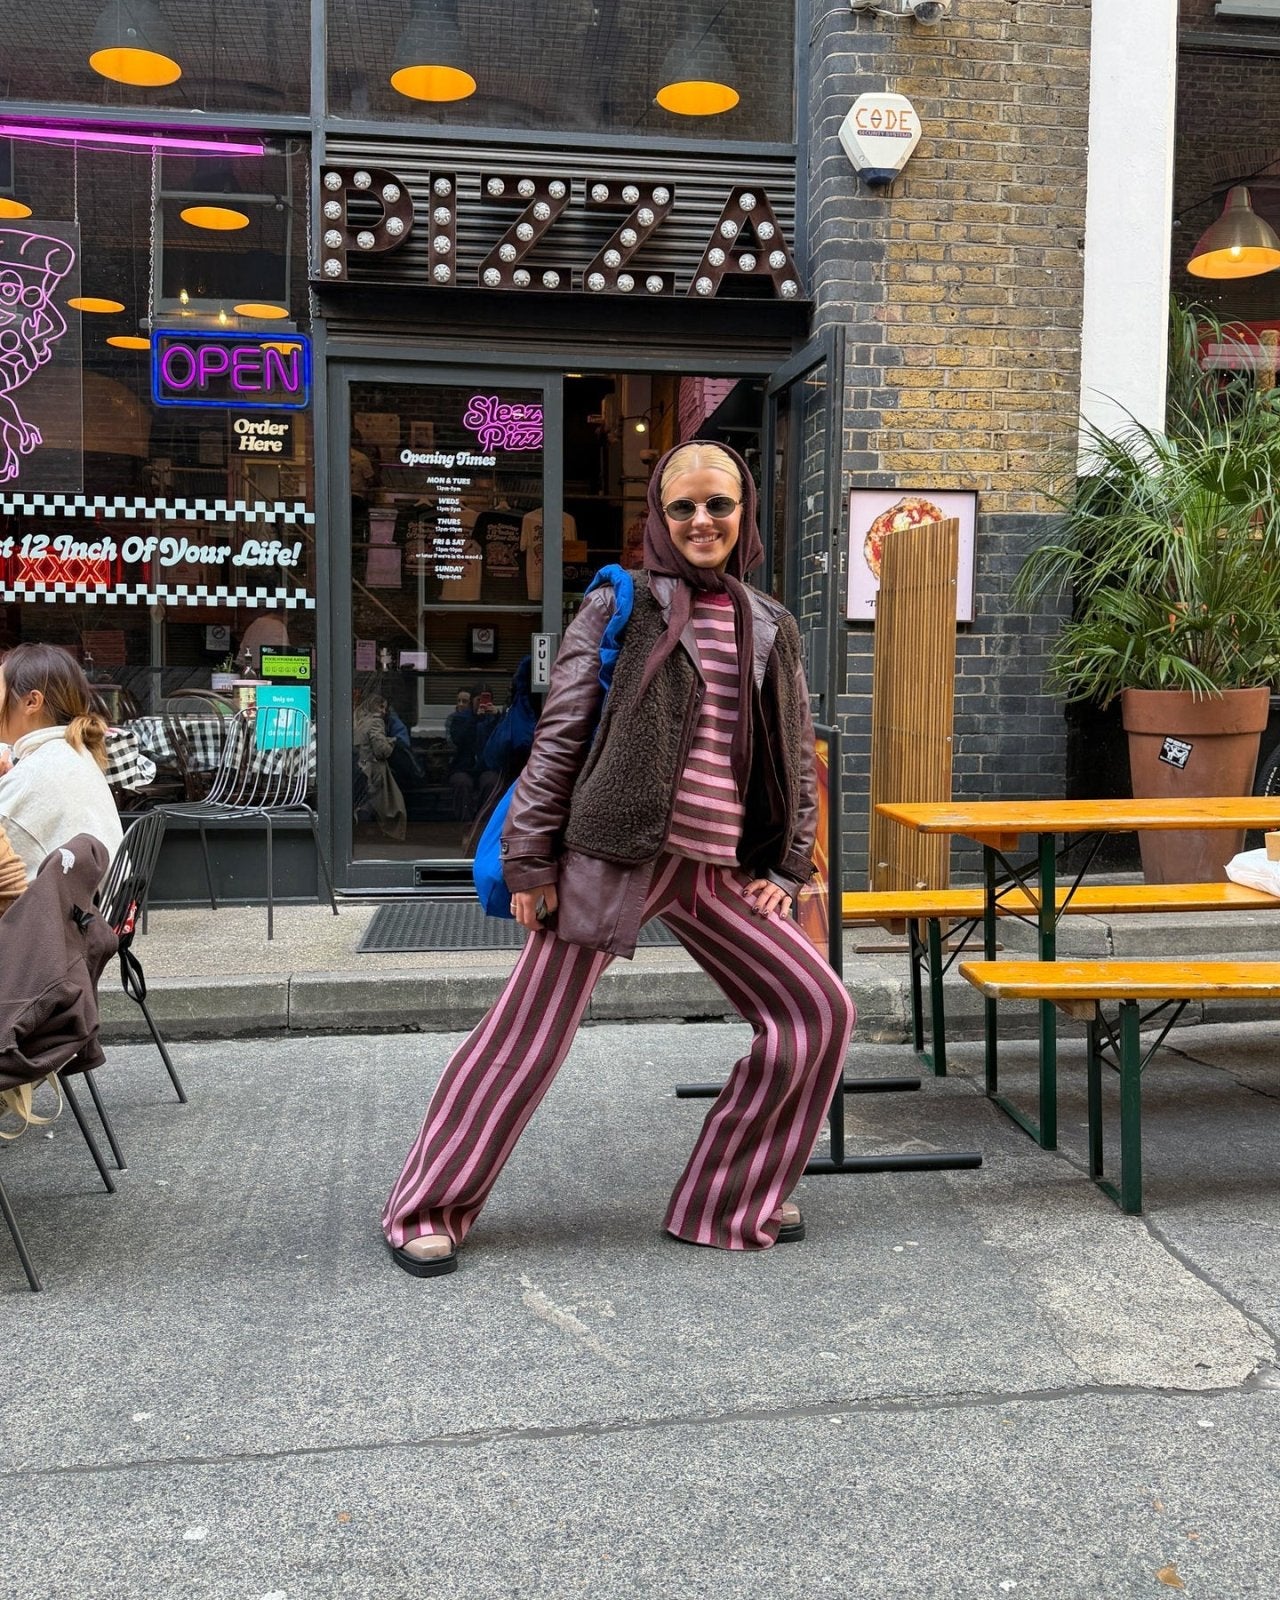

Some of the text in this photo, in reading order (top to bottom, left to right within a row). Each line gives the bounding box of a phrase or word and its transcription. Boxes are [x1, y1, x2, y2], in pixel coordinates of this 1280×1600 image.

[856, 108, 912, 130] CODE
[320, 165, 805, 298] PIZZA
[161, 345, 300, 393] OPEN
[233, 418, 289, 436] Order
[238, 435, 283, 452] Here
[400, 449, 496, 468] Opening Times
[0, 534, 302, 567] t 12 Inch Of Your Life!
[538, 639, 546, 682] PULL
